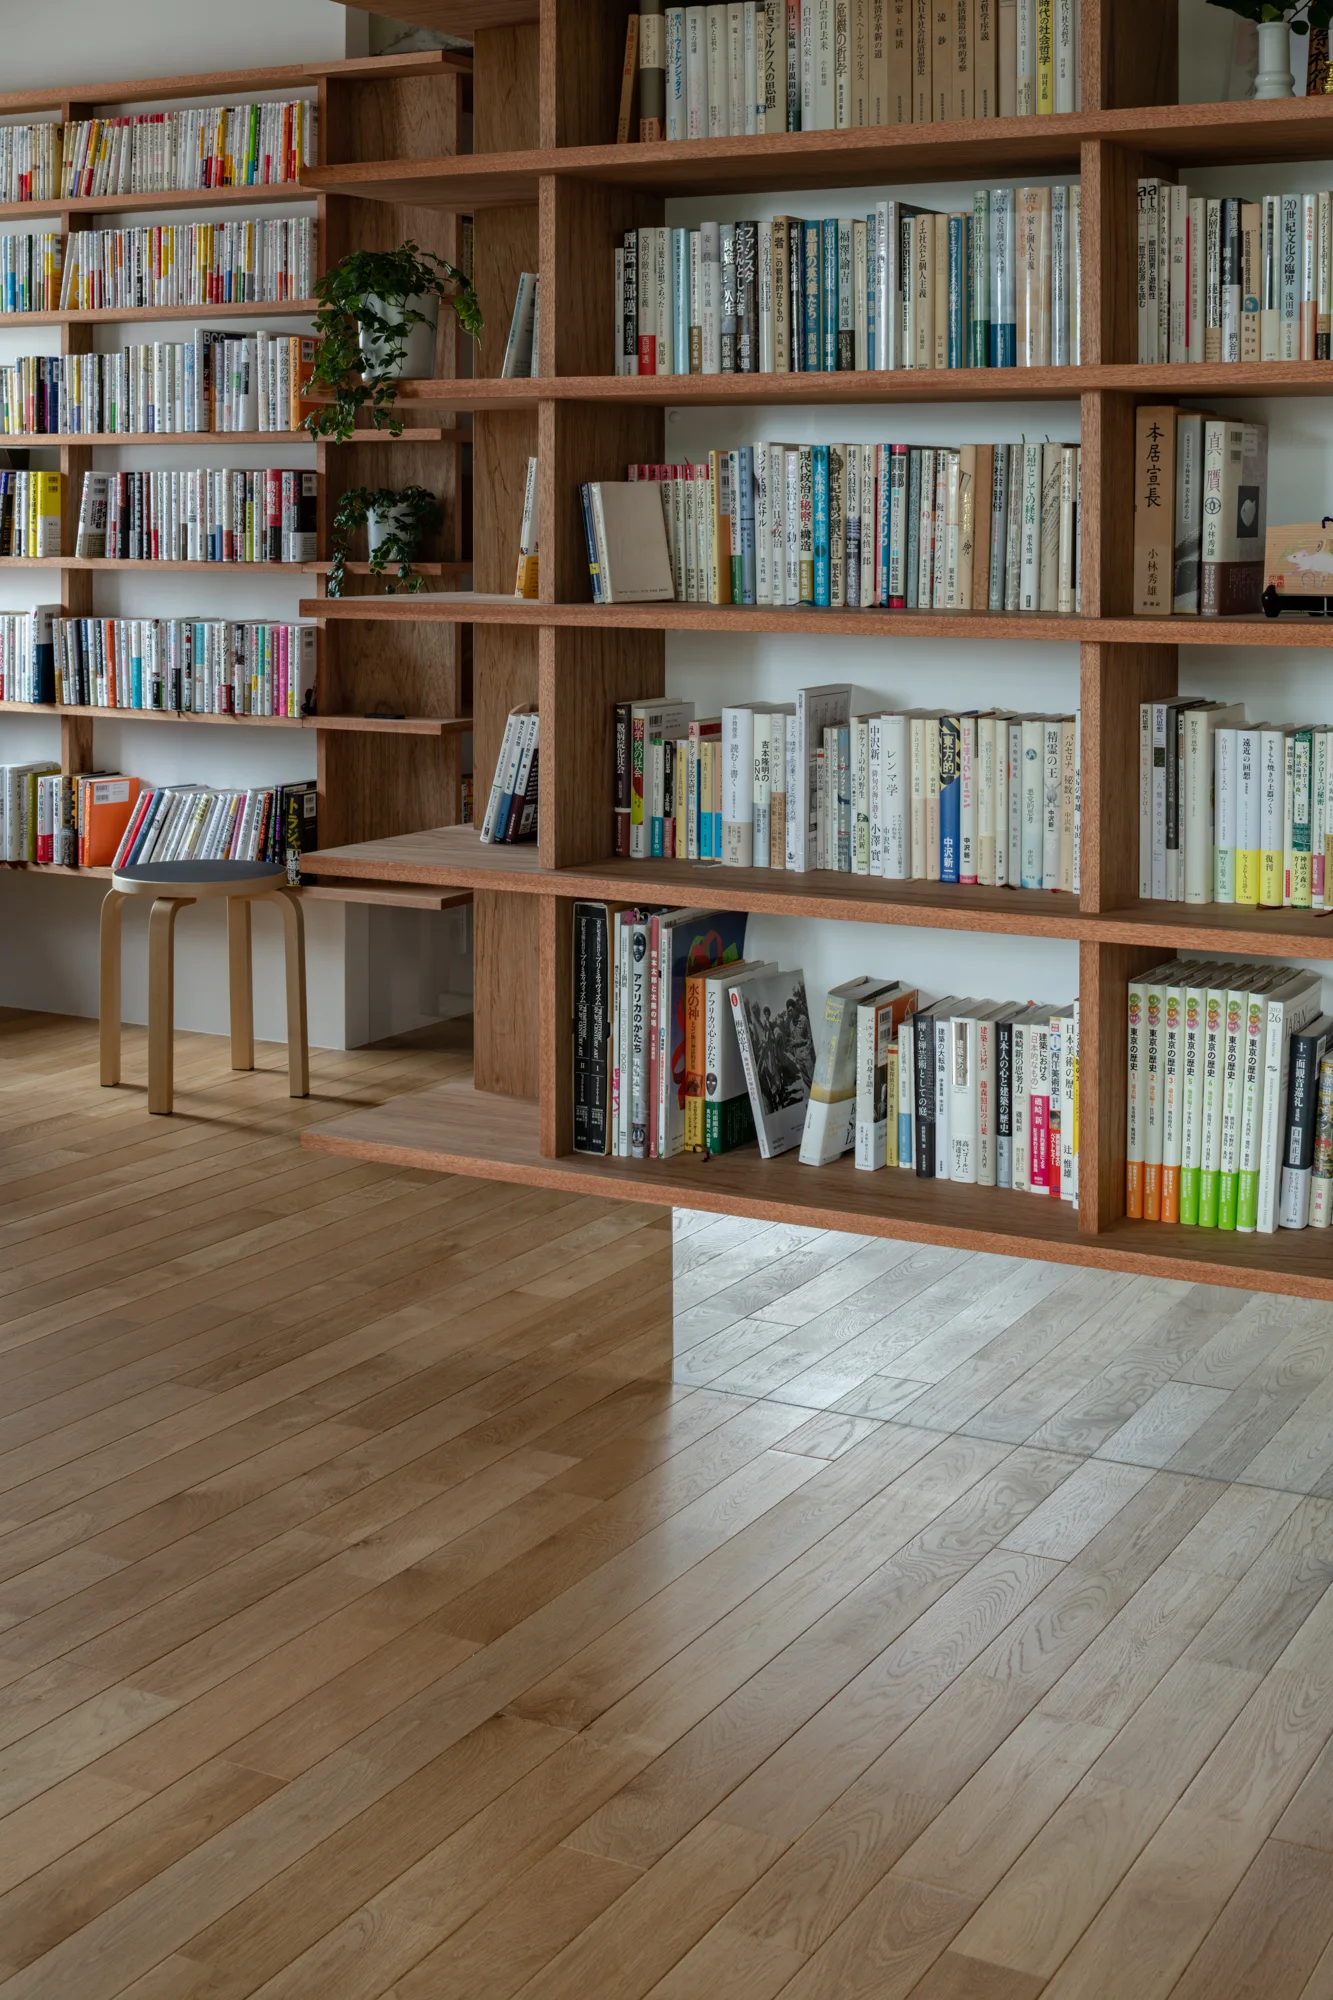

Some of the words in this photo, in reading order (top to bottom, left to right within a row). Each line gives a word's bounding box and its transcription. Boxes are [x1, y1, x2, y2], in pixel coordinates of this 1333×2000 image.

[803, 6, 812, 57] 白雲自去来
[818, 0, 828, 51] 白雲自去来
[836, 3, 848, 77] 危機の哲学
[1038, 0, 1051, 66] 時代の社会哲学
[765, 2, 777, 109] 若きマルクスの思想
[624, 232, 638, 262] 評伝
[641, 235, 650, 269] 文明の敵
[744, 226, 755, 283] ファシスタ
[774, 222, 785, 249] 学者
[839, 230, 850, 285] 福澤諭吉
[856, 229, 864, 264] ケインズ
[918, 220, 927, 299] イエ社会と個人主義
[1026, 215, 1036, 270] 家と個人主義
[1283, 198, 1298, 287] 20世紀文化の臨界
[624, 267, 638, 316] 西部邁
[641, 272, 650, 308] 民主主義
[658, 230, 666, 309] 昔、言葉は思想であった
[735, 229, 745, 317] たらんとした者
[775, 253, 784, 323] この喜劇的なるもの
[806, 228, 818, 320] 思想の英雄たち
[1222, 247, 1232, 322] 闘争のエチカ
[840, 295, 849, 328] 西部邁
[1285, 291, 1295, 319] 浅田彰
[279, 345, 290, 395] 現金の呪い
[658, 341, 666, 366] 西部邁
[721, 335, 731, 369] 西部邁
[740, 335, 750, 369] 西部邁
[808, 333, 818, 365] 西部邁
[1025, 446, 1037, 525] 幻想としての経済
[1144, 421, 1165, 508] 本居宣長
[1207, 430, 1222, 493] 真贋
[756, 449, 768, 529] パンツを脱いだサル
[799, 450, 812, 553] 現代政治の秘密と構造
[861, 521, 872, 567] 栗本慎一郎
[935, 502, 945, 584] 俺たちはノイズだ
[1206, 521, 1216, 557] 小林秀雄
[1146, 547, 1159, 597] 小林秀雄
[1141, 708, 1149, 731] 現代思想
[1155, 708, 1164, 733] 現代思想
[1189, 720, 1199, 755] 野生の思考
[633, 718, 644, 778] 脱学校の社会
[729, 742, 740, 789] 読むと書く
[761, 740, 770, 783] 吉本隆明の
[773, 737, 781, 792] 未来のルーシー
[857, 727, 866, 799] ポケットの中の野生
[870, 725, 880, 768] 中沢新一
[943, 734, 956, 774] 東方的
[962, 726, 972, 809] はじまりのレーニン
[1046, 730, 1058, 780] 精霊の王
[1063, 733, 1074, 805] バルセロナ、秘数3
[1220, 736, 1229, 792] 今日のトーテミスム
[1241, 737, 1252, 781] 遠近の回想
[1286, 744, 1294, 778] 神話と意味
[885, 749, 899, 797] レンマ学
[1266, 738, 1276, 817] やきもち焼きの土器つくり
[1315, 739, 1326, 807] サンタクロースの秘密
[287, 796, 302, 849] トラジャ
[1155, 782, 1163, 846] 人類学のゆくえ
[858, 827, 866, 855] 中沢新一
[882, 826, 891, 862] 中沢新一
[943, 836, 954, 873] 中沢新一
[963, 836, 971, 864] 中沢新一
[1265, 853, 1274, 872] 復刊
[1293, 855, 1301, 893] ガイドブック
[1299, 855, 1308, 889] 神話の森の
[632, 972, 644, 1054] アフリカのかたち
[649, 949, 658, 1029] 岡本太郎と太陽の塔
[688, 982, 700, 1020] 水の神
[706, 990, 717, 1070] アフリカの心とかたち
[1268, 1013, 1282, 1023] 26
[916, 1020, 928, 1118] 禅と禅芸術としての庭
[937, 1026, 946, 1073] 建築の大転換
[979, 1025, 988, 1072] 建築とは何か
[1014, 1029, 1024, 1095] 磯崎新の思考力
[1030, 1030, 1039, 1090] 「日本的なもの」
[1038, 1032, 1049, 1082] 建築における
[1065, 1023, 1075, 1101] 日本美術の歴史
[1129, 1027, 1140, 1072] 東京の歴史
[1148, 1028, 1158, 1073] 東京の歴史
[1167, 1031, 1176, 1076] 東京の歴史
[1186, 1032, 1196, 1077] 東京の歴史
[1206, 1034, 1217, 1078] 東京の歴史
[1227, 1035, 1238, 1081] 東京の歴史
[1247, 1038, 1258, 1084] 東京の歴史
[998, 1030, 1010, 1134] 日本人の心と建築の歴史
[1050, 1051, 1060, 1096] 西洋美術史
[1292, 1041, 1308, 1108] 十一面観音巡礼
[979, 1080, 989, 1136] 藤森照信の言葉
[1033, 1097, 1043, 1125] 磯崎新
[961, 1139, 970, 1174] 高いゴールに
[1291, 1126, 1301, 1164] 白洲正子
[1314, 1183, 1324, 1211] 三浦展
